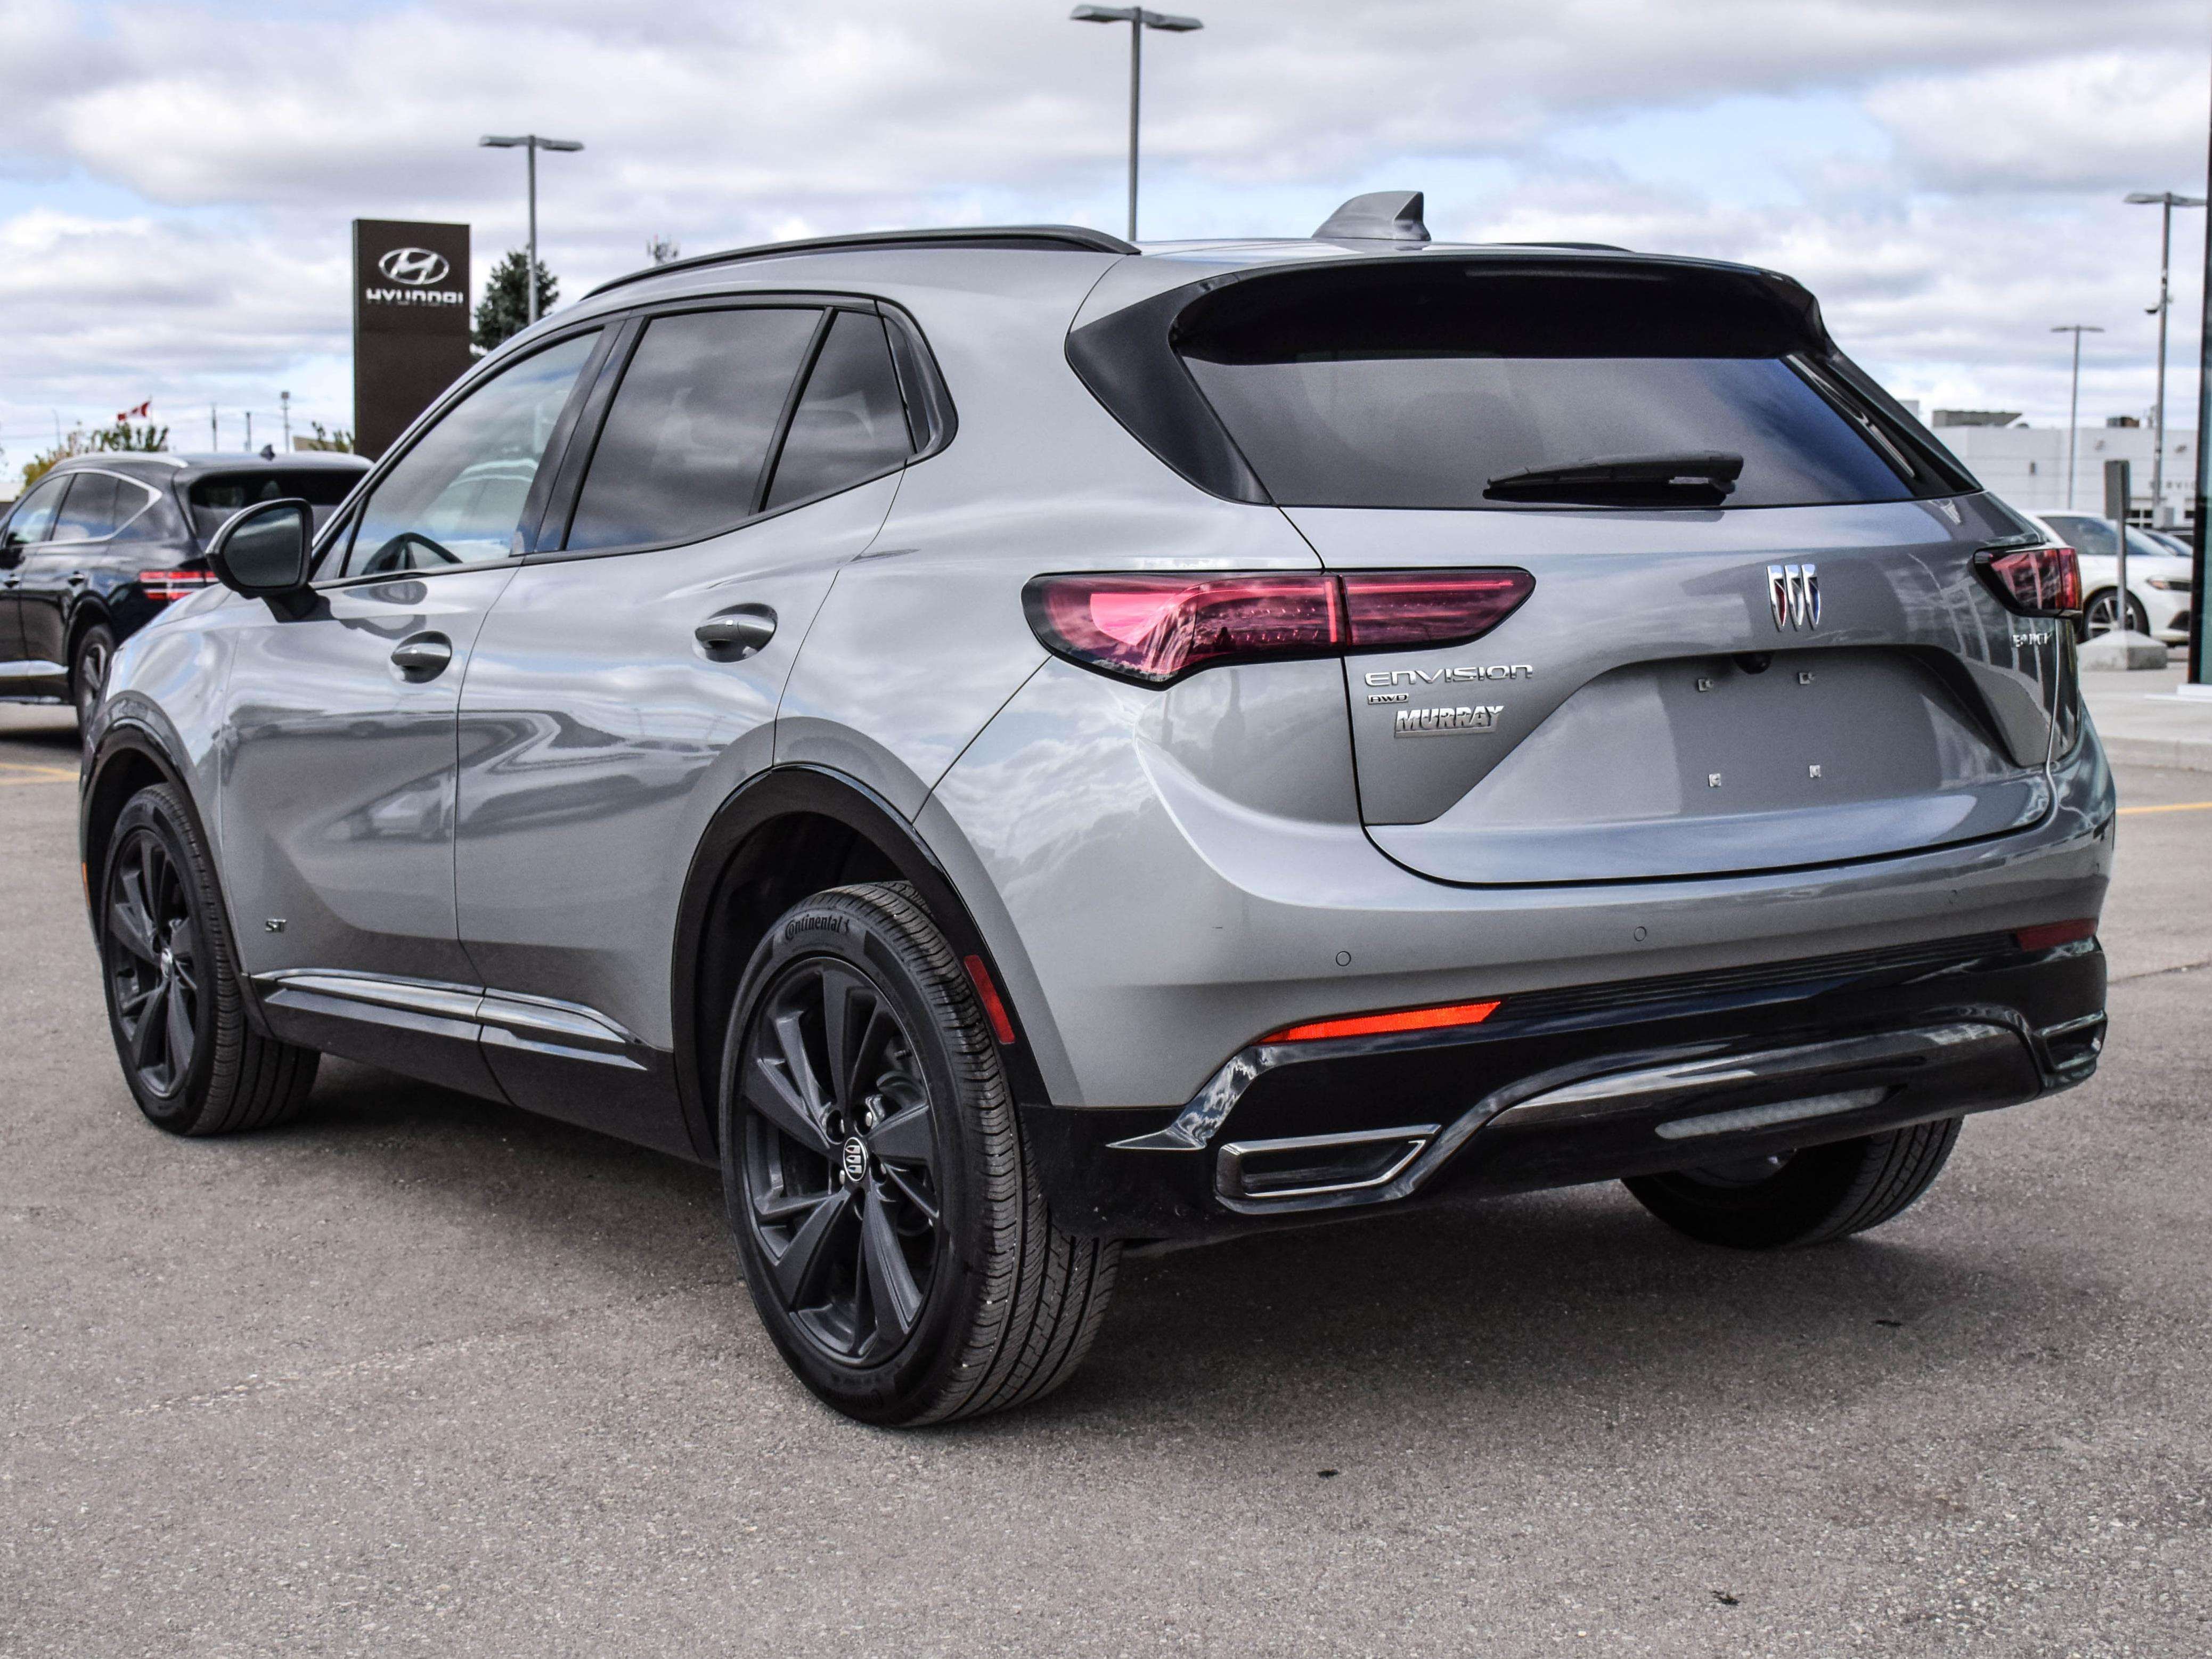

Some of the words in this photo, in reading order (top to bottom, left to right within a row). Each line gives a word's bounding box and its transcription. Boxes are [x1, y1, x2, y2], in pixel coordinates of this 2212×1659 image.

[365, 288, 464, 306] HYUNDAI
[1365, 664, 1533, 687] ENVISION
[1369, 694, 1408, 703] AWD
[1394, 706, 1504, 734] MURRAY
[785, 914, 843, 941] Continental
